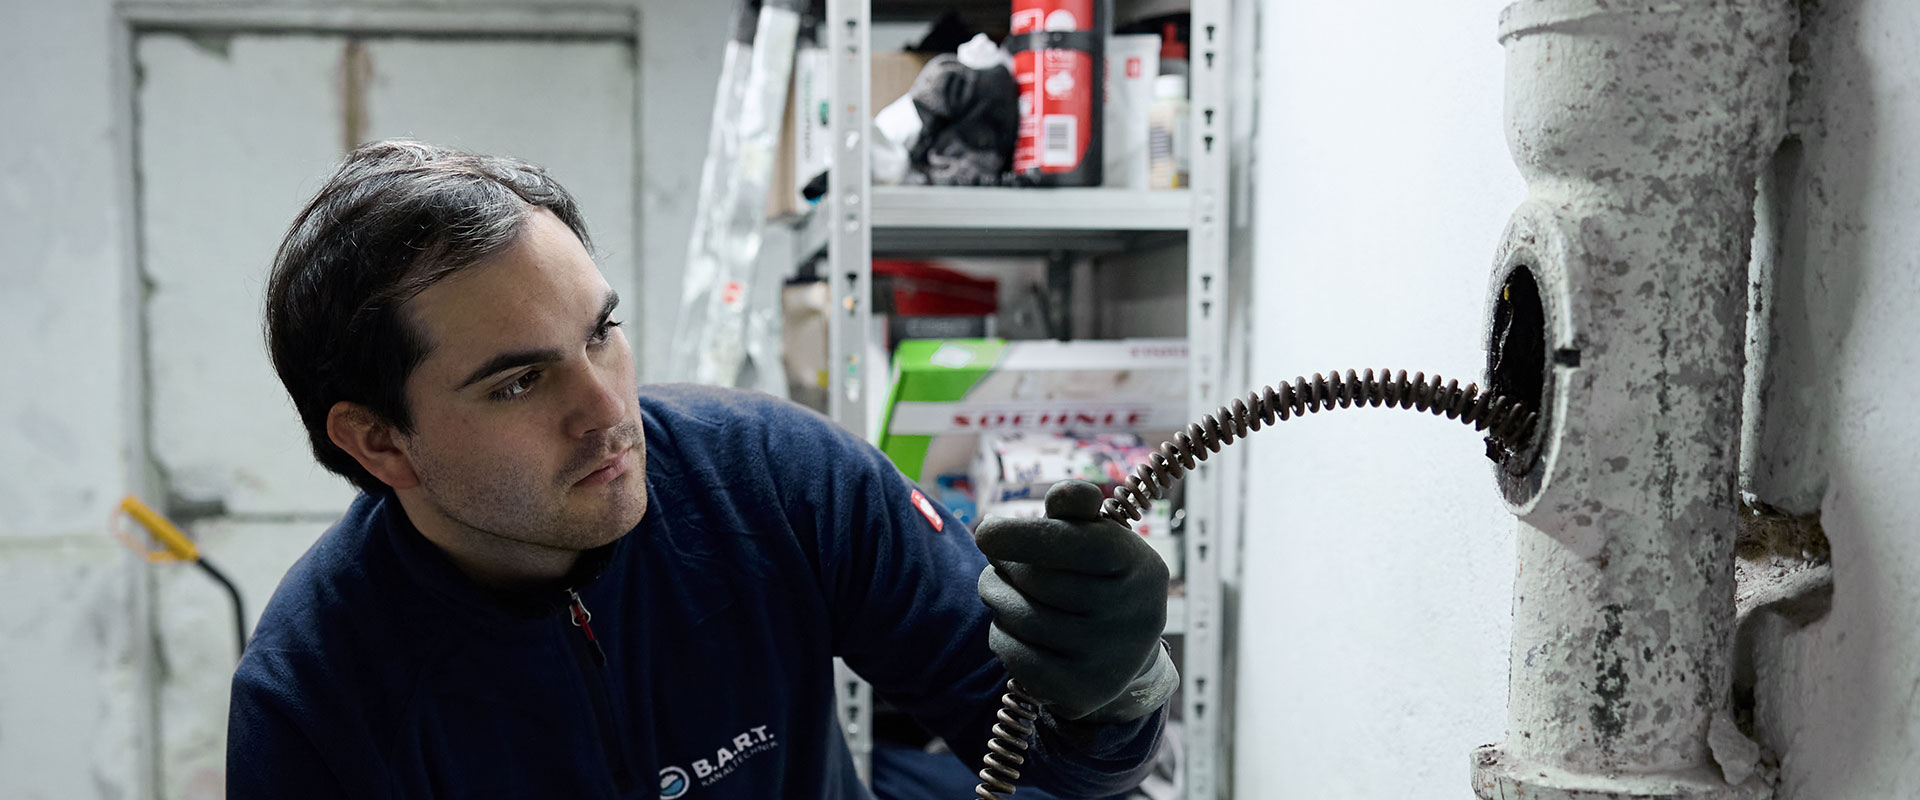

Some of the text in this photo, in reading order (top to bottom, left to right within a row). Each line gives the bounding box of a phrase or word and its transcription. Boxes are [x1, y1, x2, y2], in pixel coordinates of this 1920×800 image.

[953, 409, 1149, 428] SOEHNLE
[691, 725, 775, 778] B.A.R.T.
[701, 741, 778, 786] KANALTECHNIK
